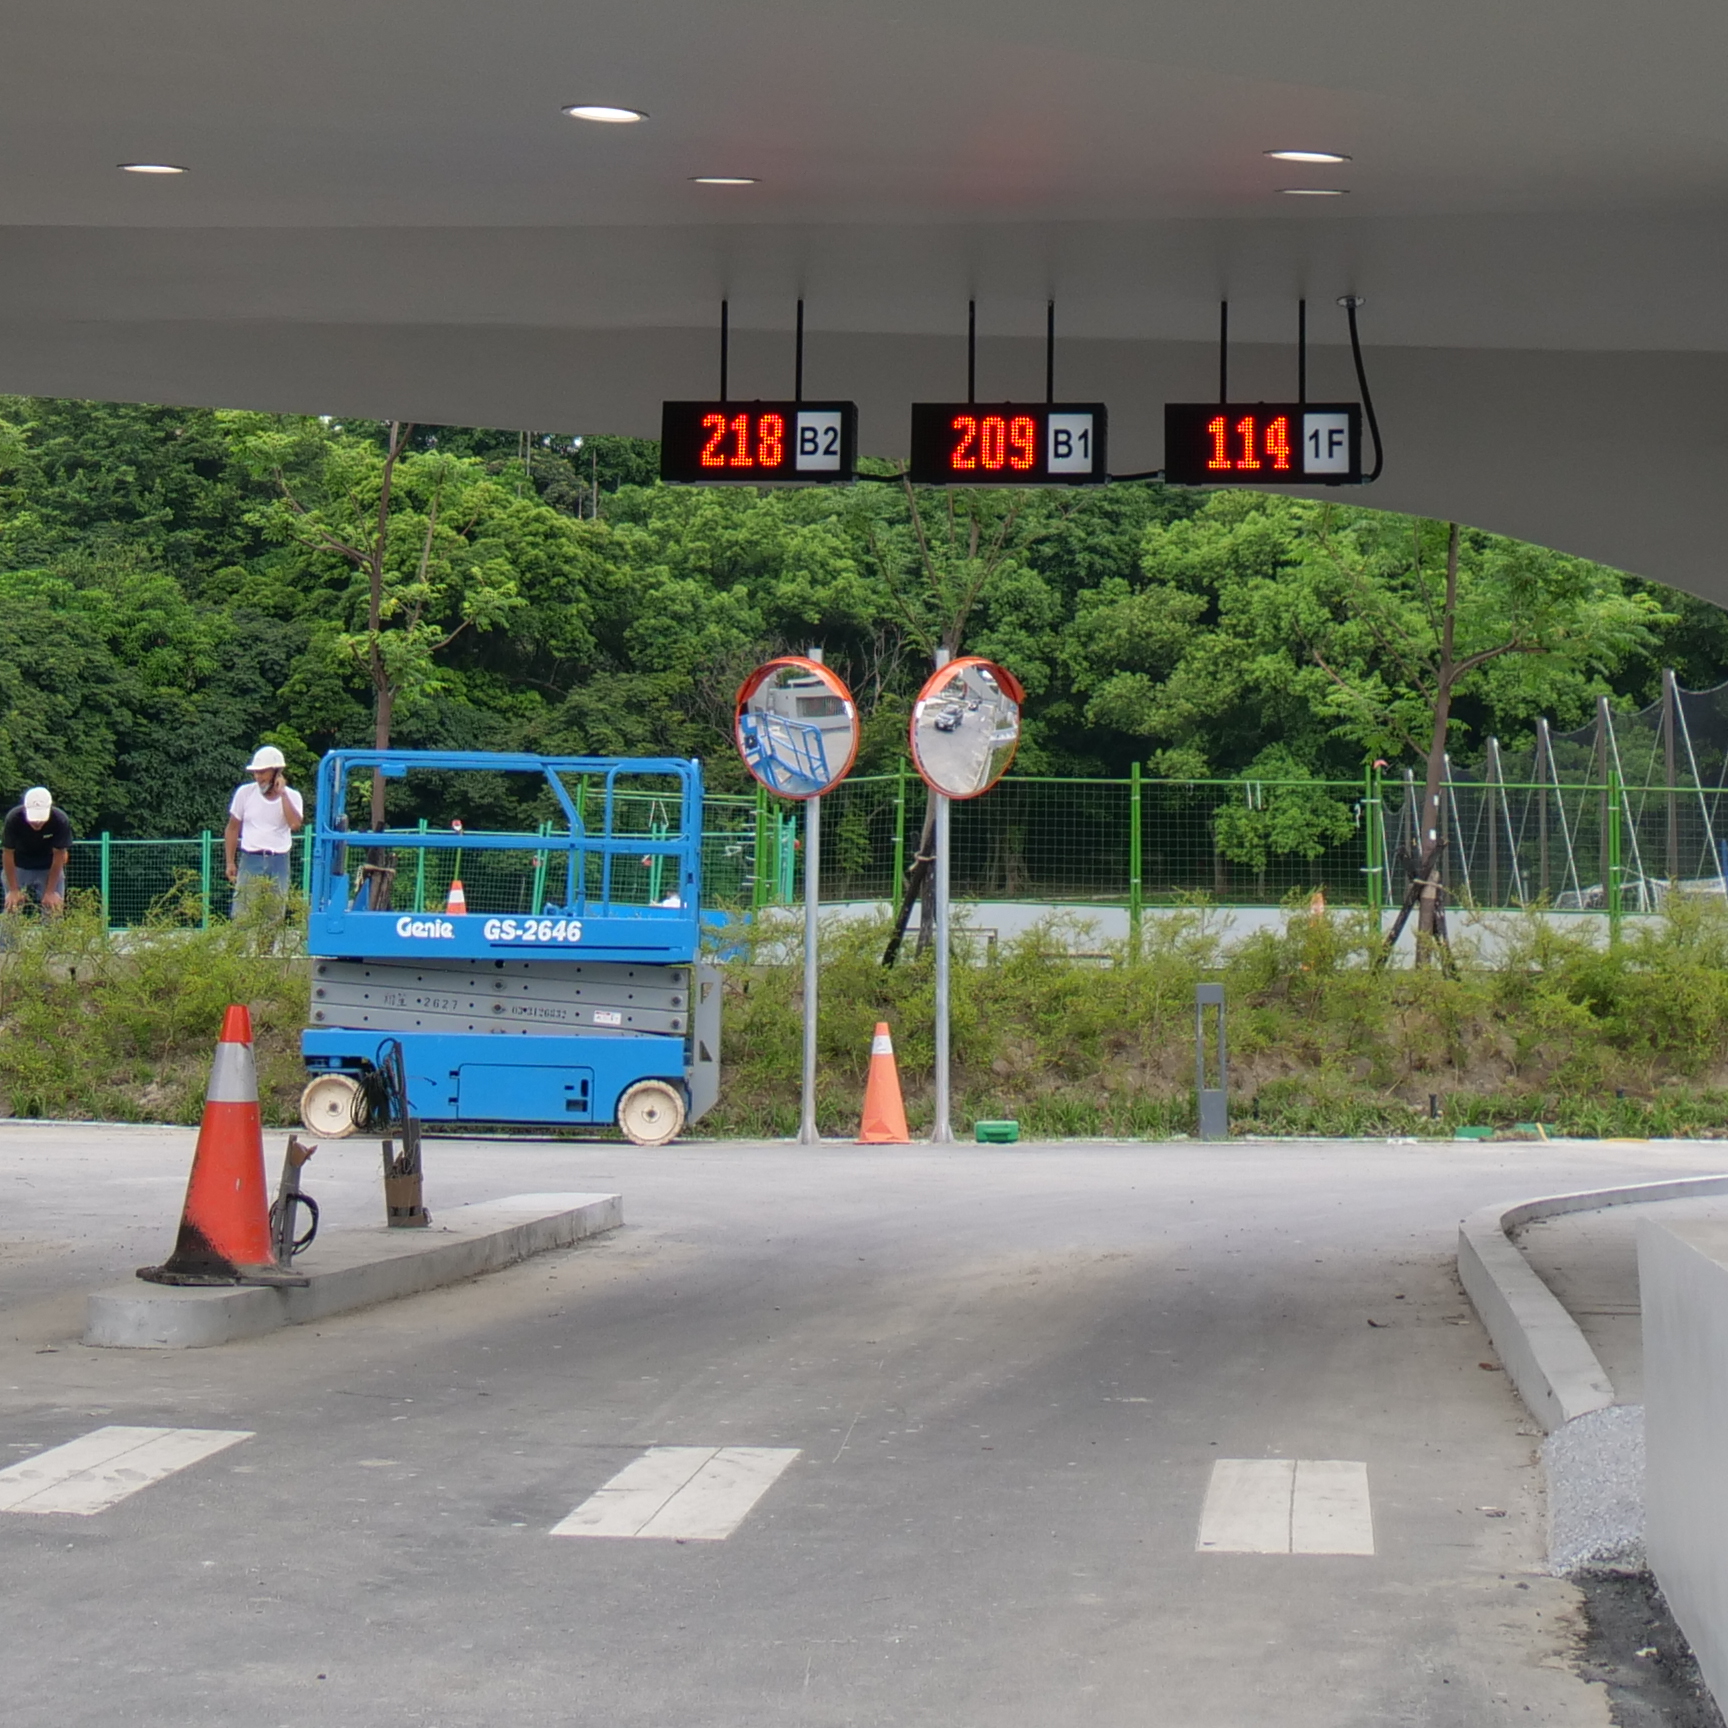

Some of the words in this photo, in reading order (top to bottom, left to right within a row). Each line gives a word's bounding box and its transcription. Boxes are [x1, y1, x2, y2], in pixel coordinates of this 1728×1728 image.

[700, 413, 784, 467] 218
[799, 426, 841, 457] B2
[951, 415, 1036, 470] 209
[1052, 427, 1092, 460] B1
[1206, 416, 1291, 470] 114
[1308, 428, 1346, 460] 1F
[396, 916, 455, 939] Genie
[483, 918, 583, 942] GS-2646
